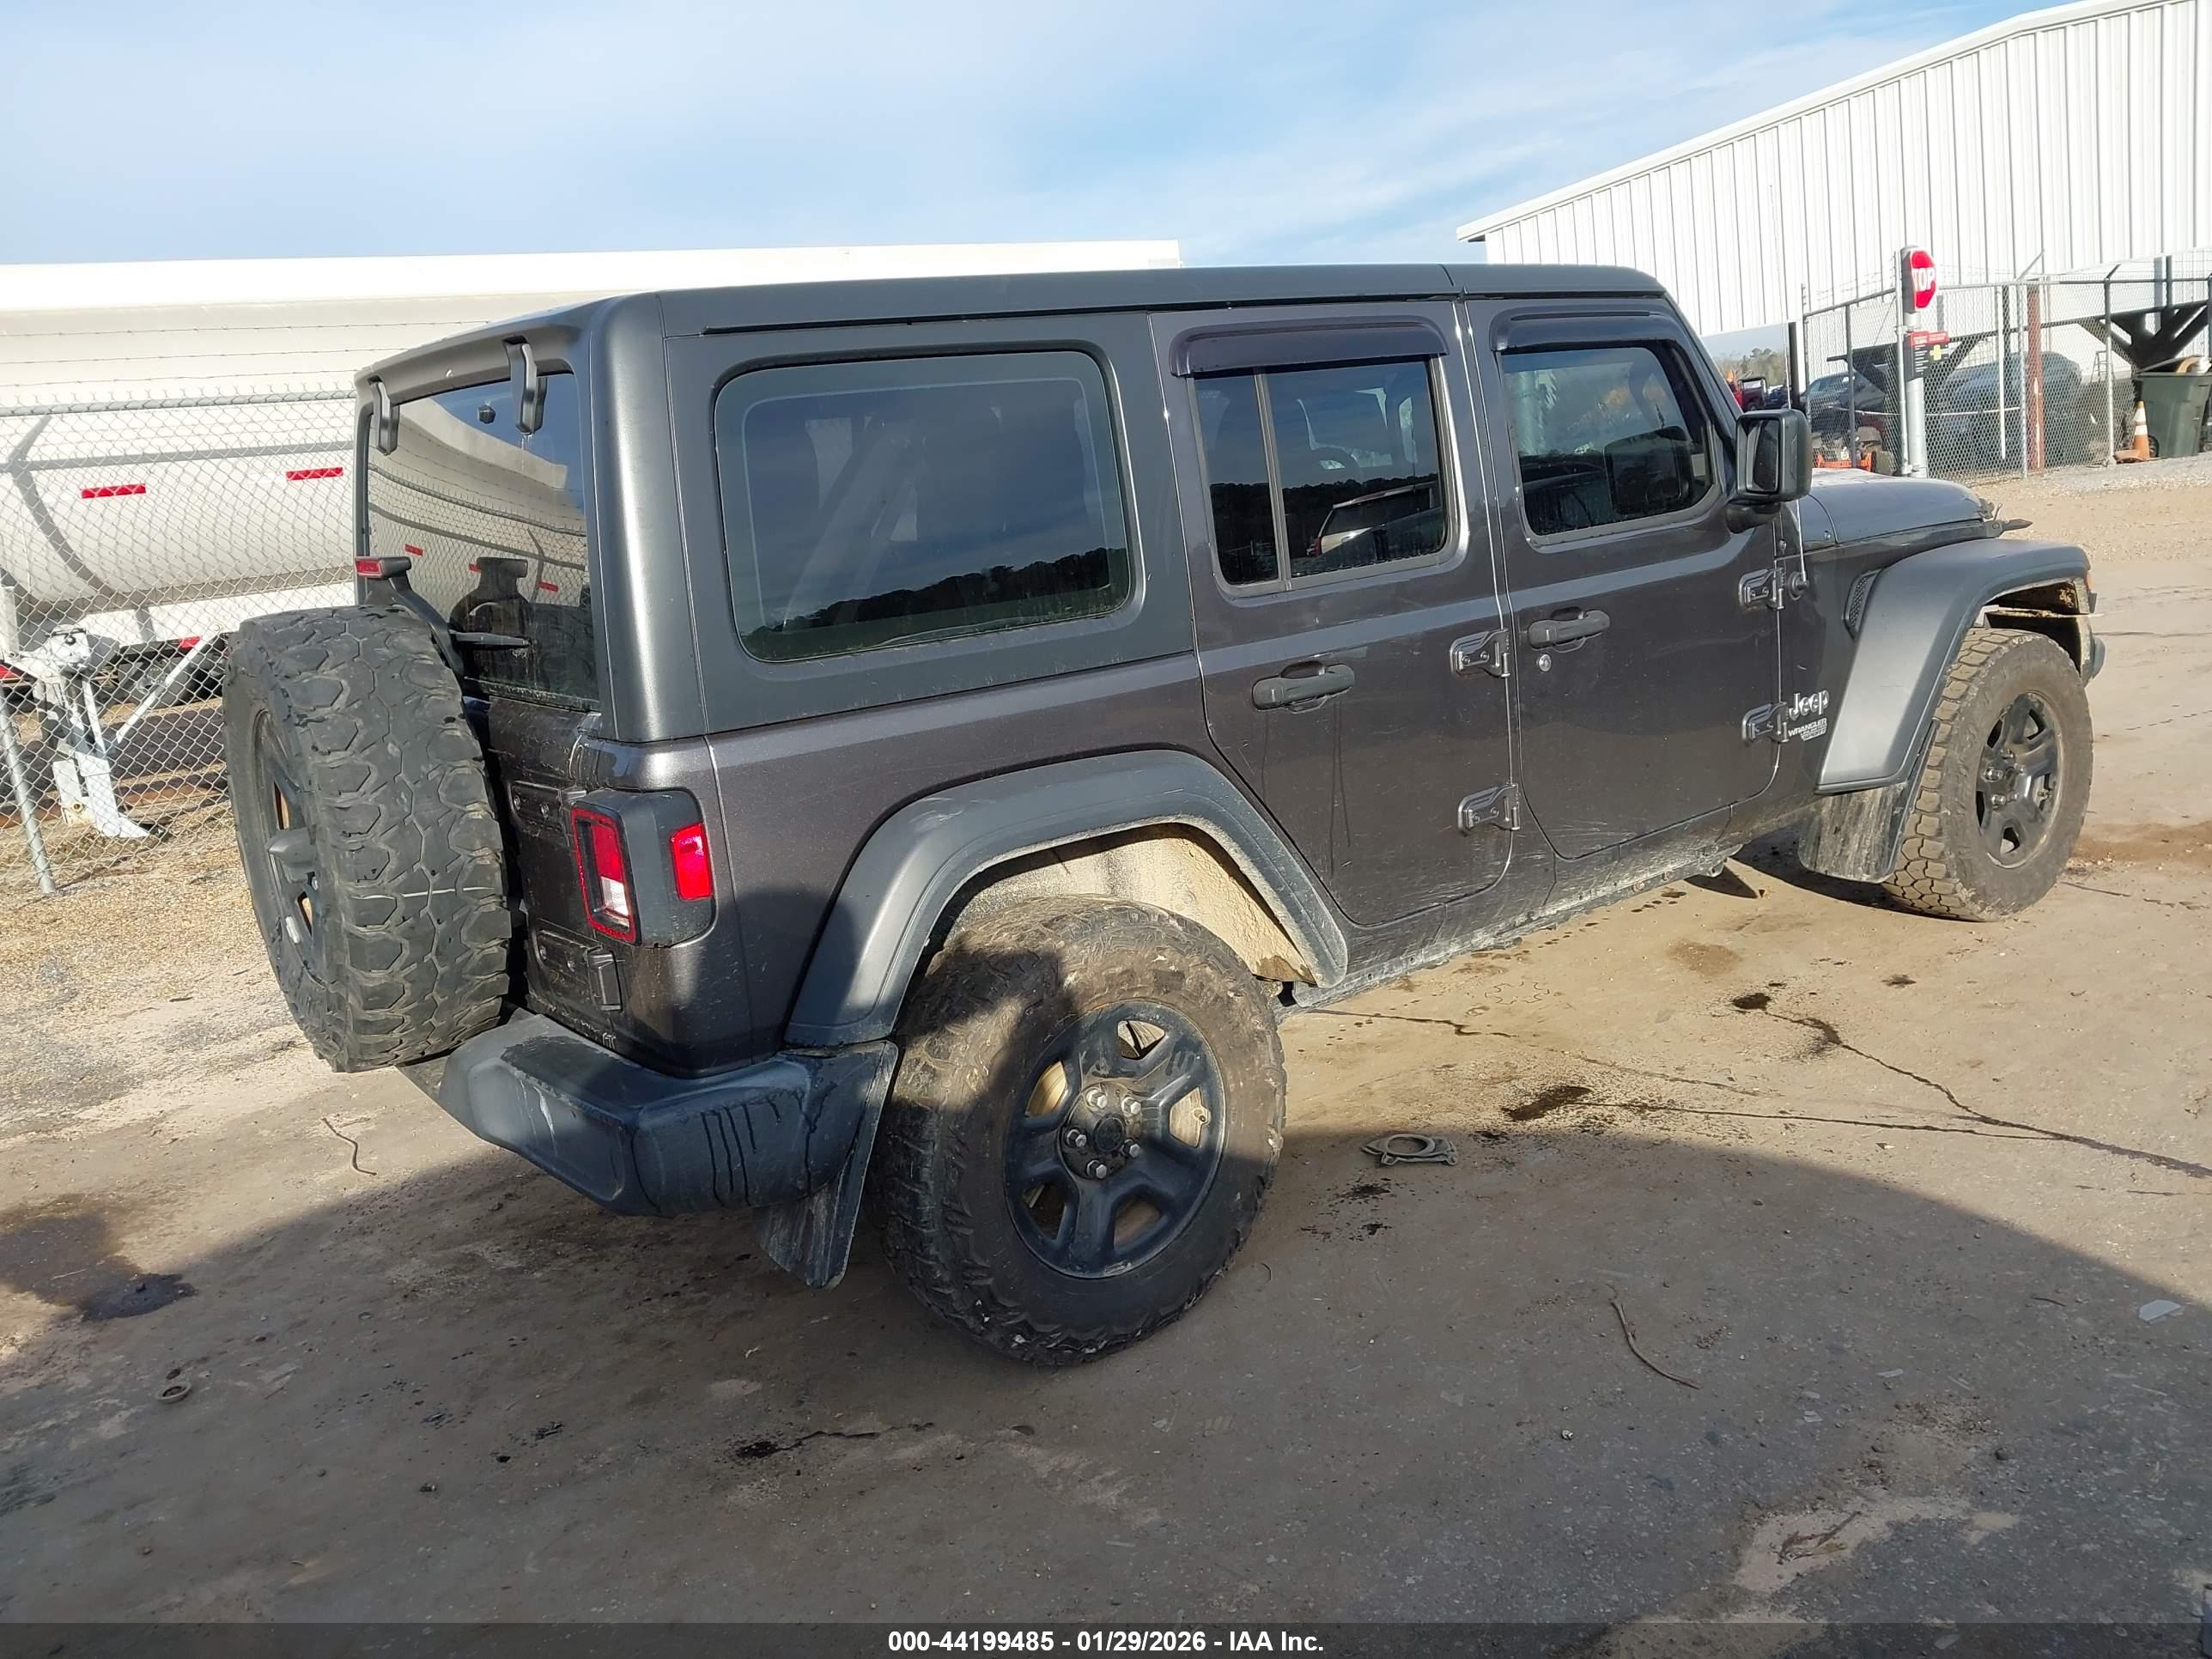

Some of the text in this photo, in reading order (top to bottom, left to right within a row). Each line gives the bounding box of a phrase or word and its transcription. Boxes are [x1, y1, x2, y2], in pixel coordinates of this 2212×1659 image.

[1911, 267, 1936, 292] TOP
[1789, 690, 1829, 721] Jeep
[1788, 718, 1827, 737] WRANGLER
